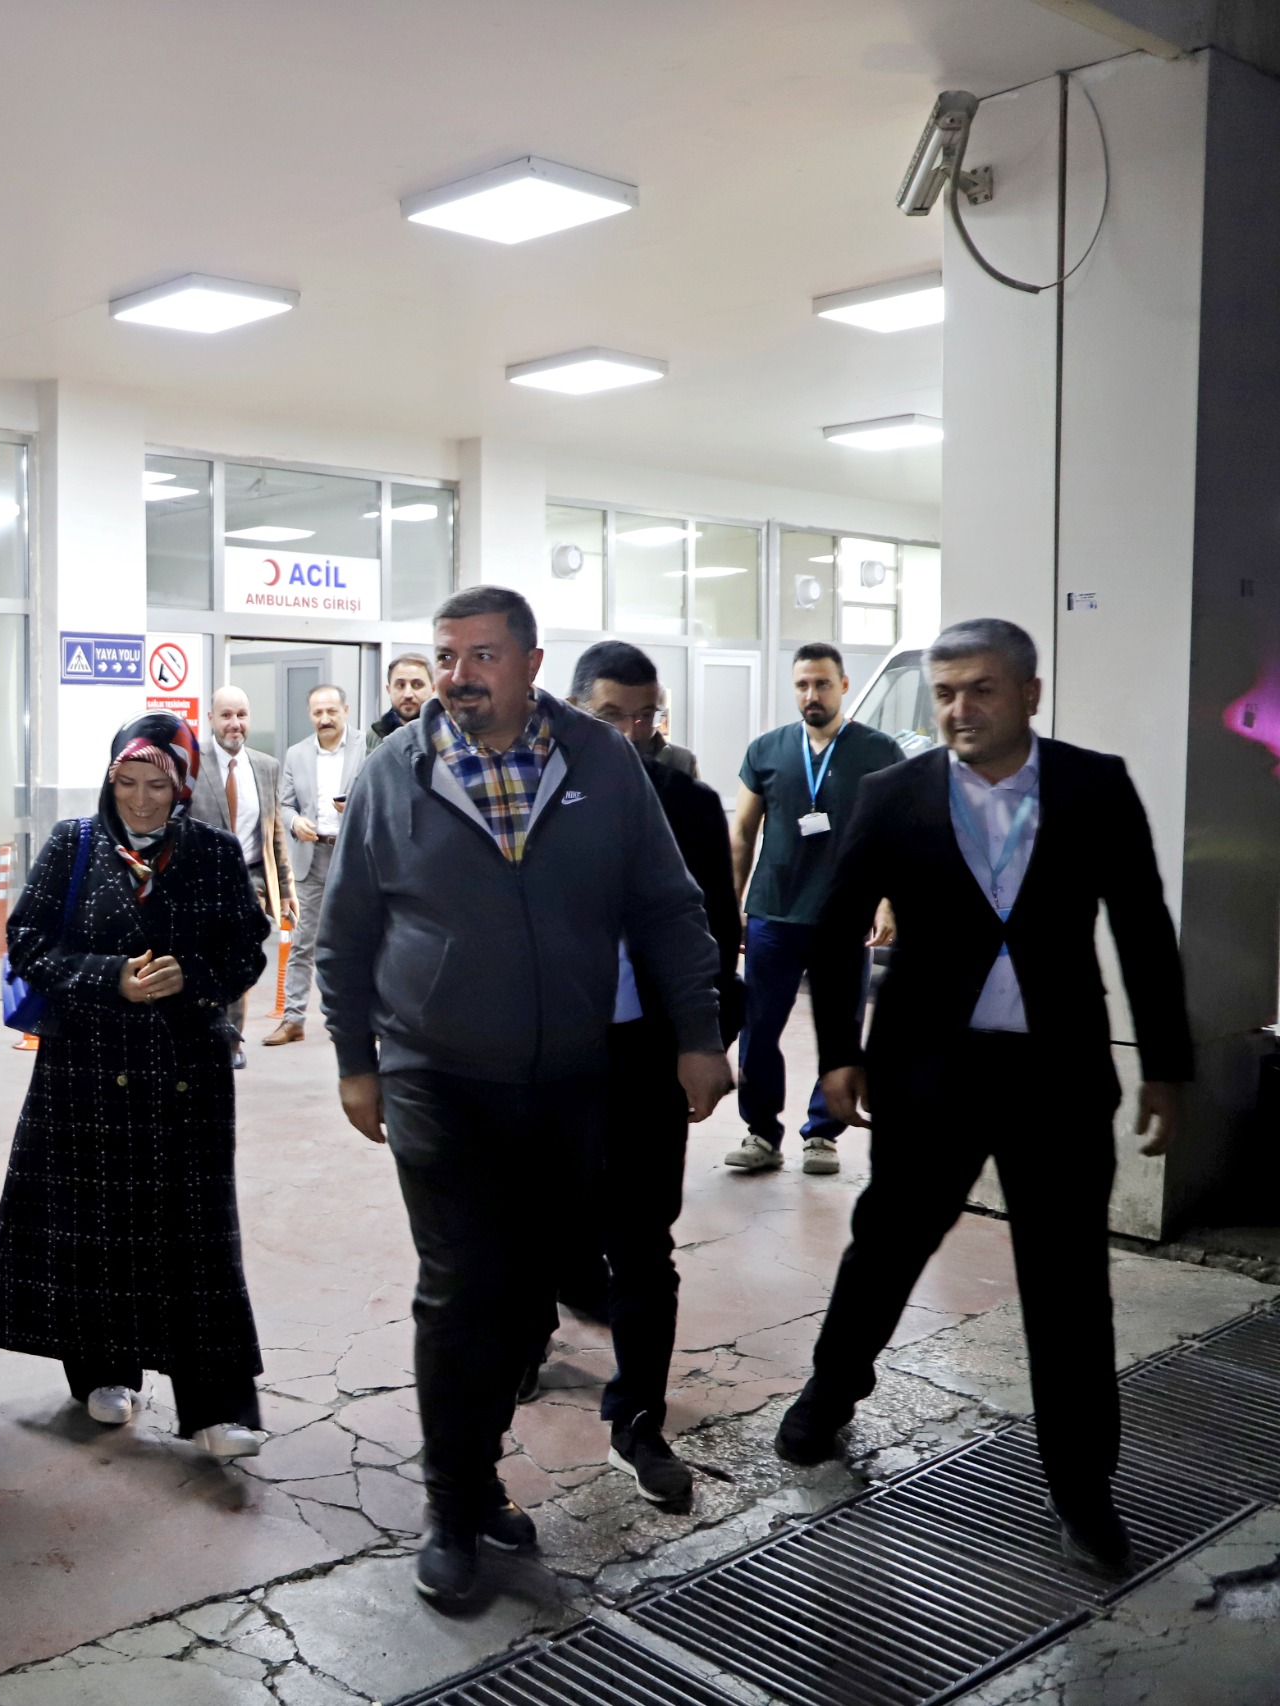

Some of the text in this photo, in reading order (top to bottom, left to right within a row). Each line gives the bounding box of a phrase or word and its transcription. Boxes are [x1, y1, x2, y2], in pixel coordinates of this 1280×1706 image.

[288, 560, 347, 588] ACİL
[245, 593, 361, 613] AMBULANS GİRİŞİ
[95, 647, 141, 662] YAYA YOLU
[565, 790, 581, 799] NIKE
